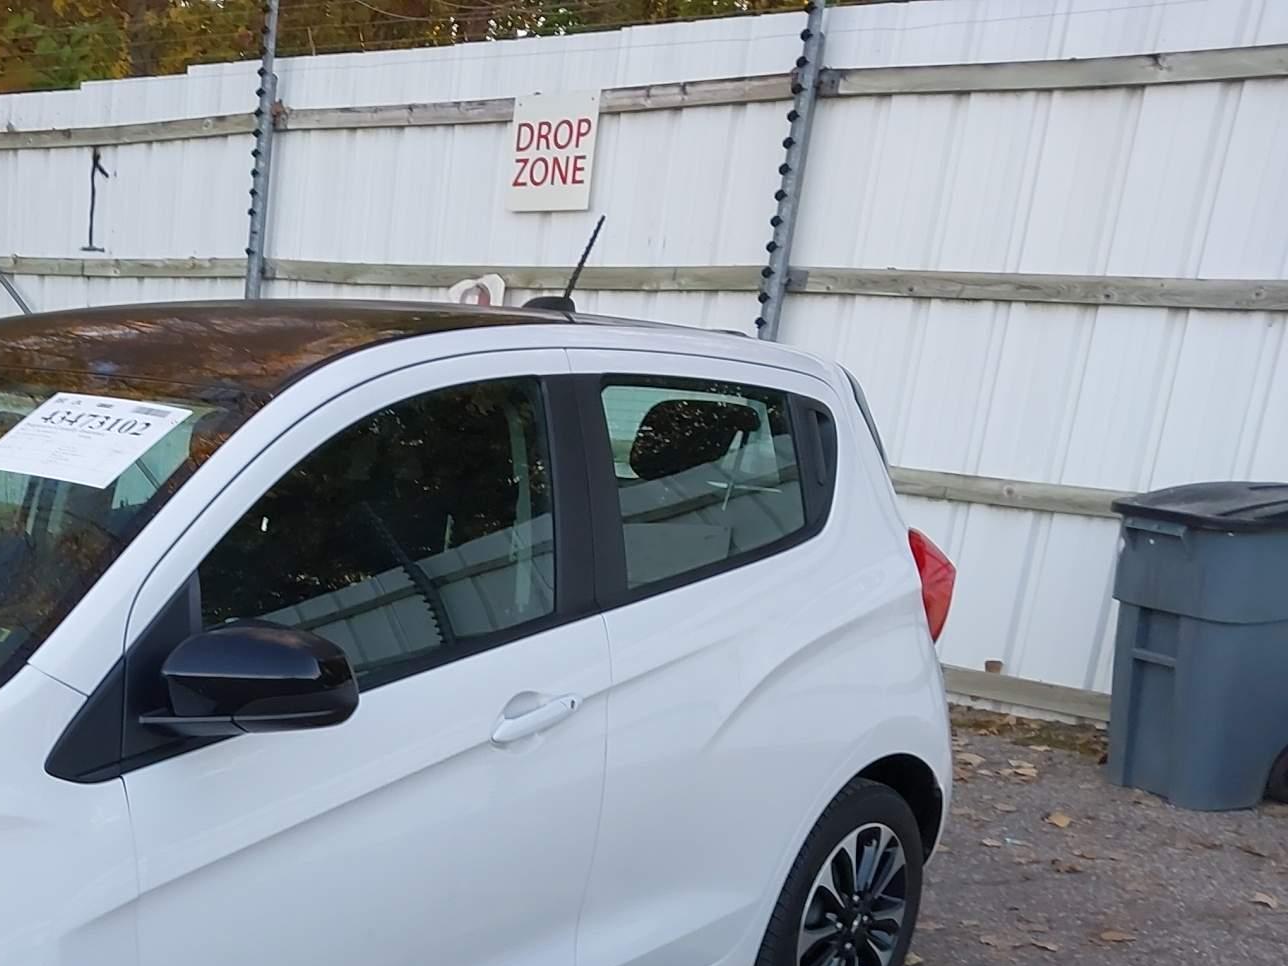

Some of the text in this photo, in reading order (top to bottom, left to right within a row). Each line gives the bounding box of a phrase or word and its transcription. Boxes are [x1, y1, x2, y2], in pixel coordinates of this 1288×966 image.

[516, 118, 592, 152] DROP
[512, 155, 587, 187] ZONE
[40, 409, 152, 436] 43473102
